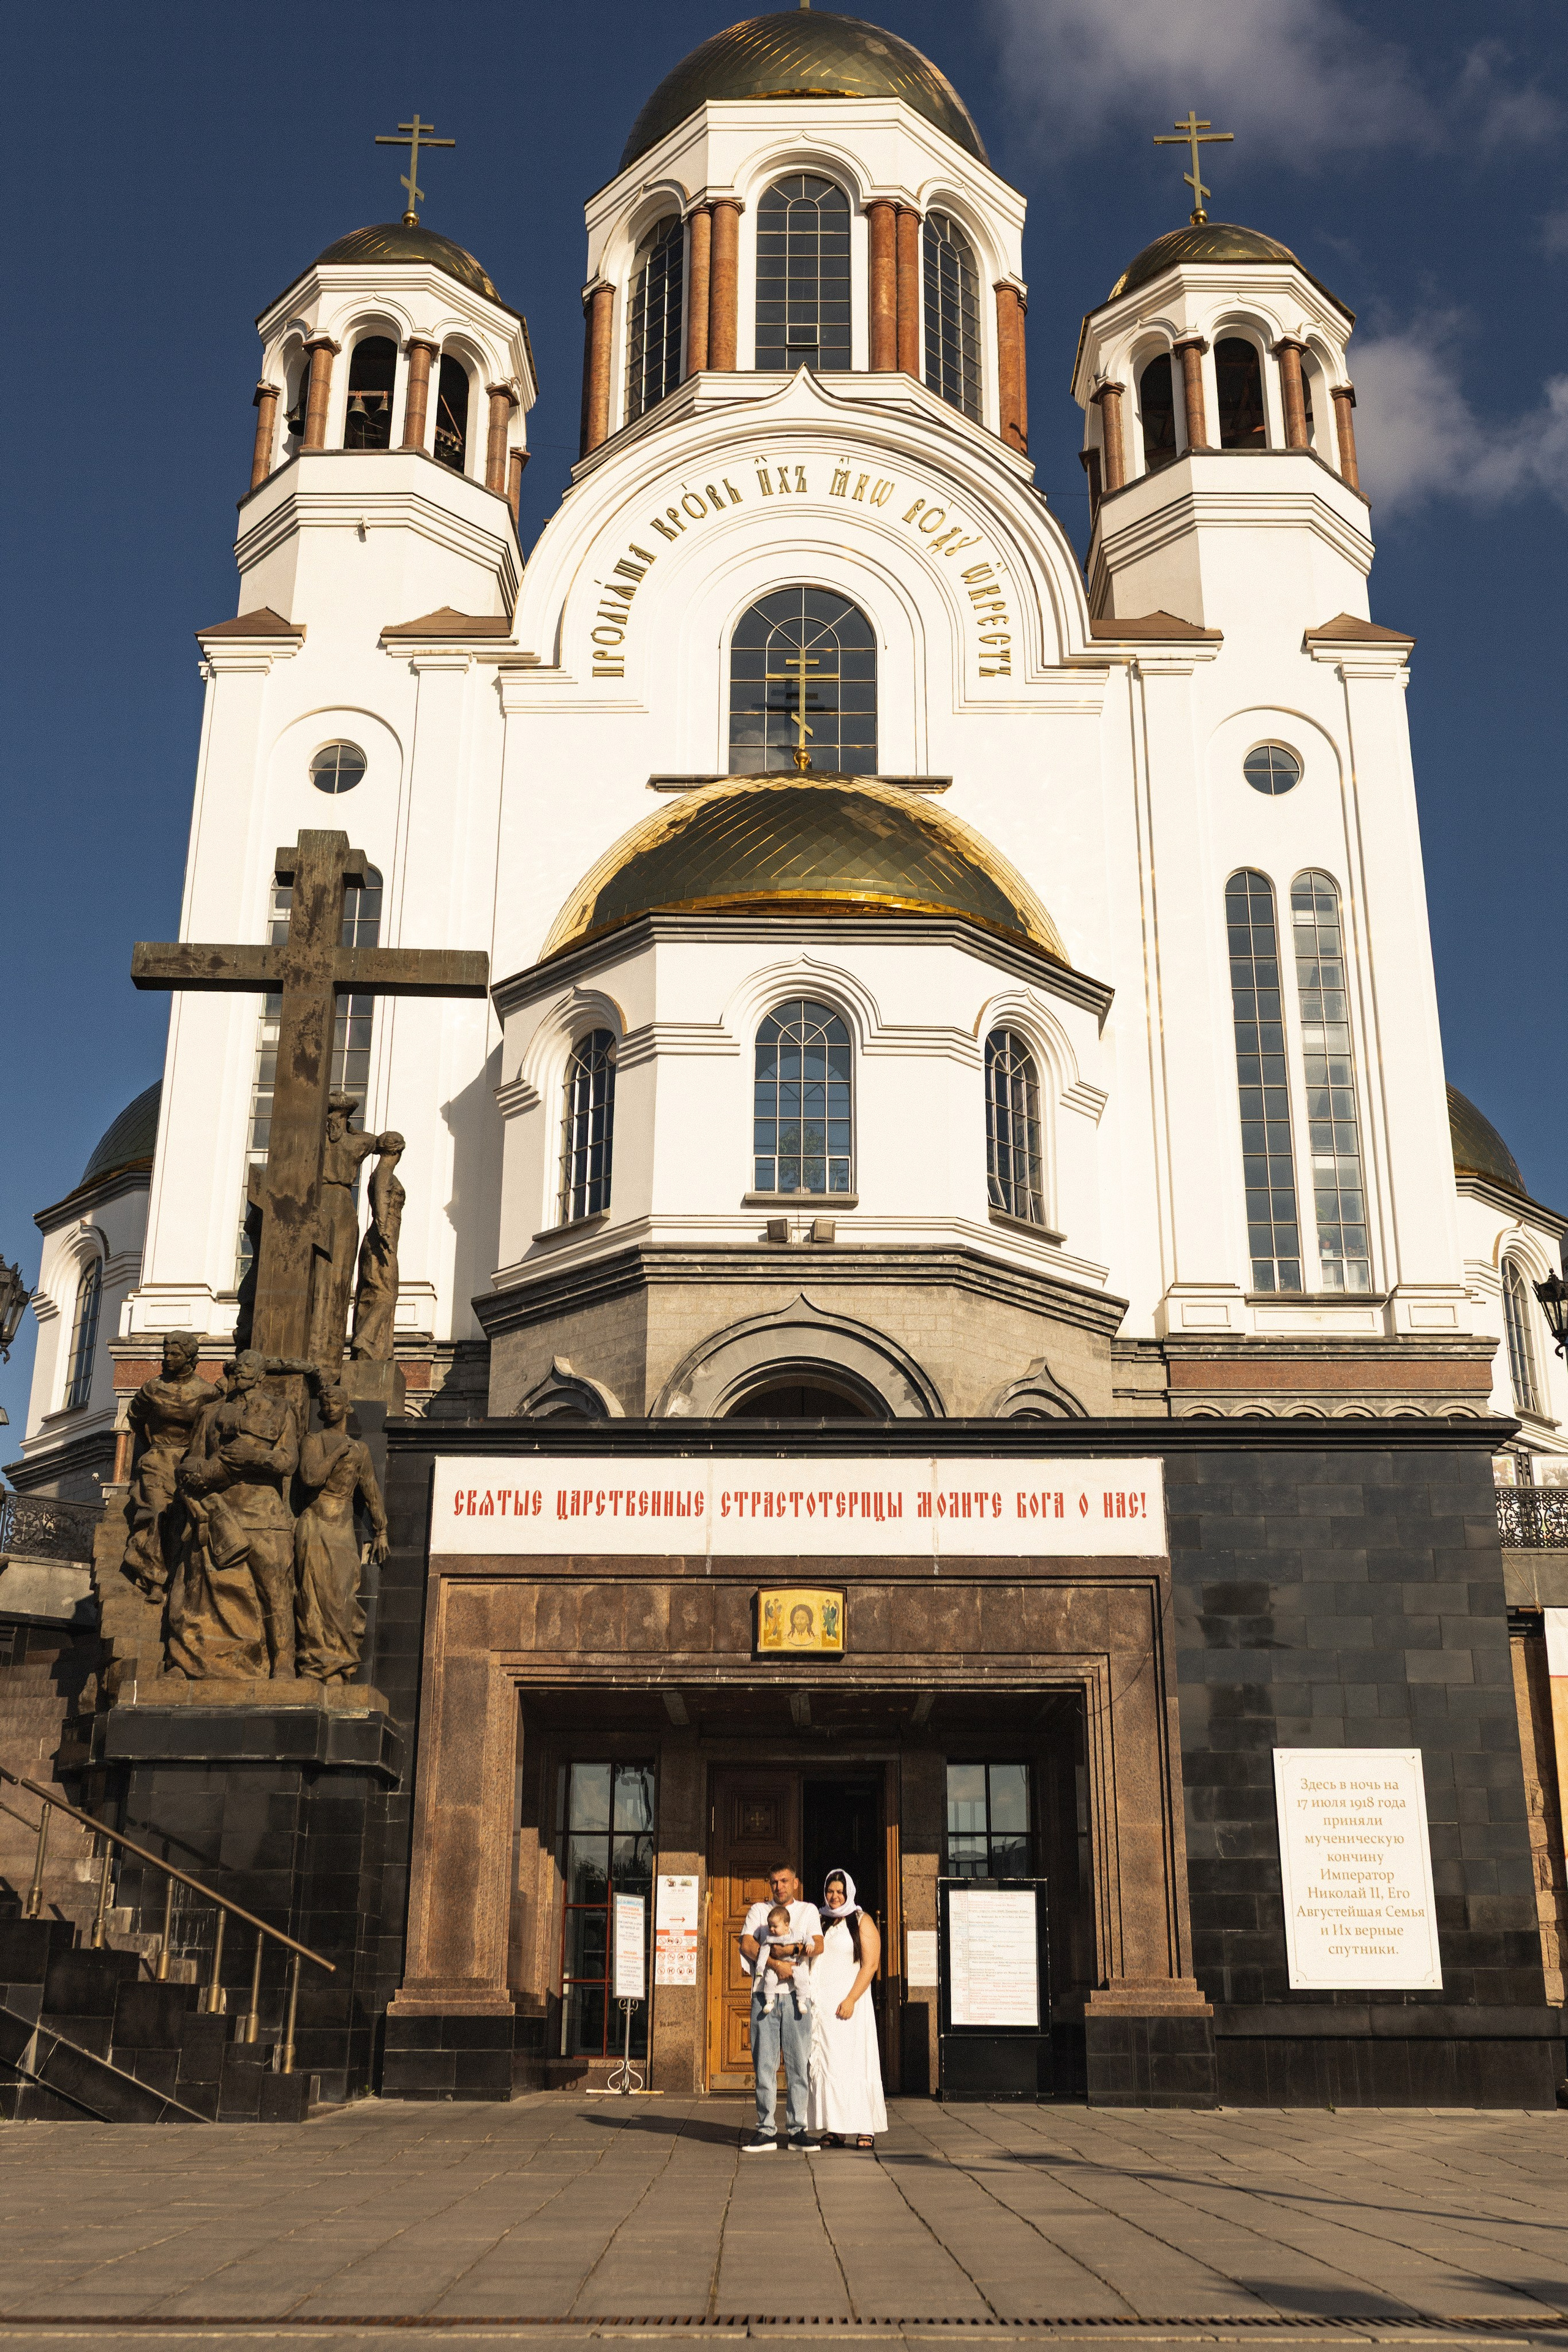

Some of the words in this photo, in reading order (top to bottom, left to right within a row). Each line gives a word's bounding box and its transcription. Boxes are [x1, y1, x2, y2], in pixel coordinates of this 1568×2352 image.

[557, 1490, 704, 1520] ЦАРСТВЕННЫЕ
[721, 1491, 903, 1522] СТРАСТОТЕРПЦЫ
[917, 1492, 1002, 1518] МОЛИТЕ
[1017, 1492, 1065, 1518] БОГА
[1079, 1492, 1088, 1518] О
[1103, 1492, 1147, 1518] НАС!
[1300, 1778, 1336, 1792] Здесь
[1339, 1782, 1347, 1790] в
[1350, 1782, 1381, 1790] ночь
[1384, 1782, 1400, 1790] на
[1297, 1800, 1308, 1811] 17
[1311, 1800, 1346, 1808] июля
[1351, 1796, 1374, 1811] 1918
[1378, 1800, 1406, 1810] года
[1324, 1817, 1383, 1828] приняли
[1305, 1835, 1404, 1847] мученическую
[1327, 1853, 1384, 1865] кончину
[1321, 1868, 1395, 1883] Император
[1307, 1886, 1366, 1899] Николай
[1388, 1887, 1411, 1899] Его
[1296, 1905, 1382, 1920] Августейшая
[1385, 1905, 1425, 1917] Семья
[1333, 1924, 1351, 1936] Их
[1355, 1927, 1404, 1939] верные
[1328, 1945, 1399, 1958] спутники.
